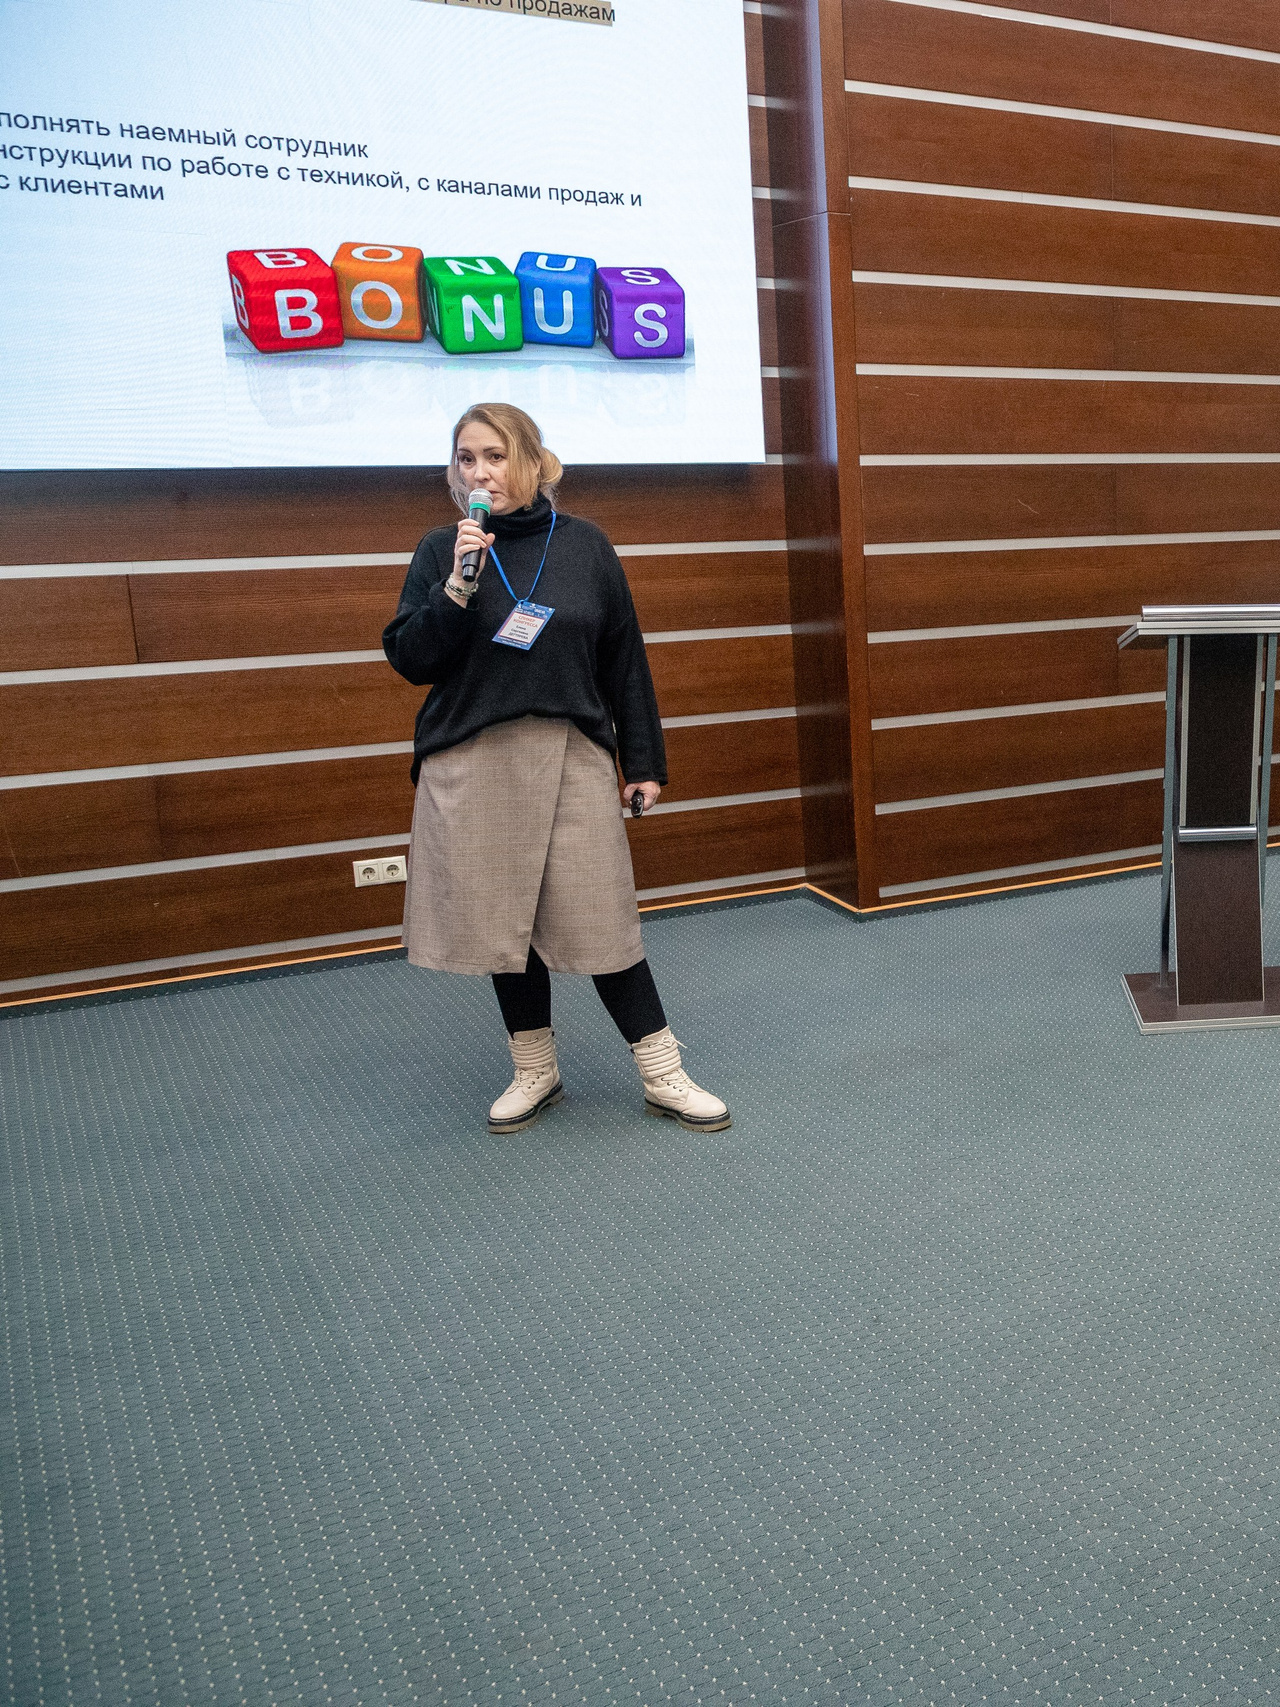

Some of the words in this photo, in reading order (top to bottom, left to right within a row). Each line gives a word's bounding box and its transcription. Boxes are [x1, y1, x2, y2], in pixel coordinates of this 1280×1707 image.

[510, 0, 615, 21] продажам
[119, 123, 237, 147] наемный
[245, 133, 369, 158] сотрудник
[19, 175, 165, 201] клиентами
[142, 155, 171, 172] по
[180, 156, 269, 179] работе
[277, 166, 290, 180] с
[297, 167, 410, 193] техникой,
[417, 177, 430, 191] с
[436, 178, 541, 200] каналами
[548, 187, 625, 207] продаж
[631, 193, 642, 207] и
[274, 280, 669, 348] BONUS
